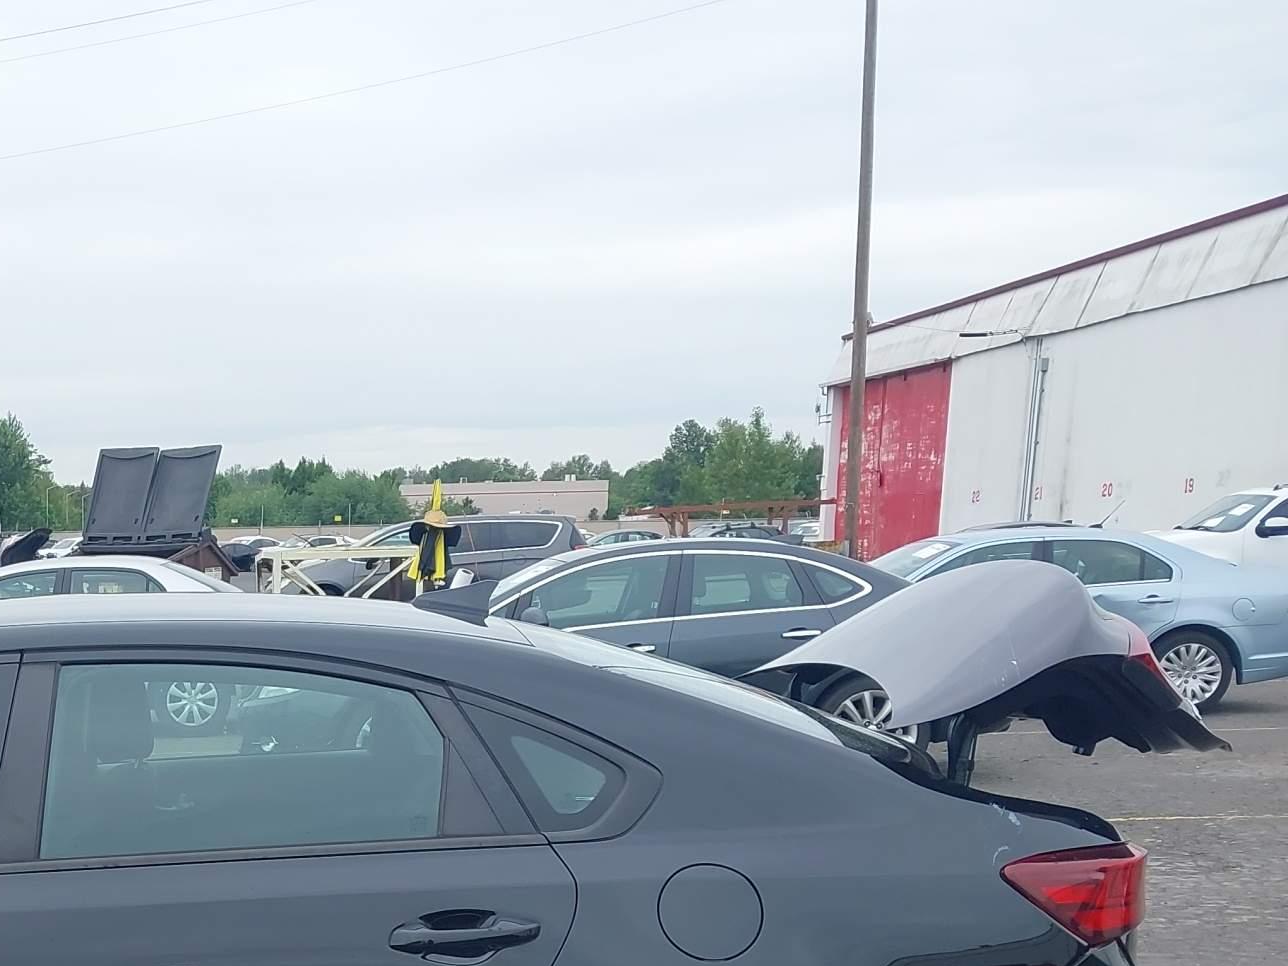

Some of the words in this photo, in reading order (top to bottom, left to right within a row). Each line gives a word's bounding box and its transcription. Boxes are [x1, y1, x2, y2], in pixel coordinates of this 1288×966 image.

[1101, 483, 1113, 498] 20
[1184, 478, 1194, 493] 19
[971, 490, 981, 503] 22
[1034, 486, 1043, 500] 21
